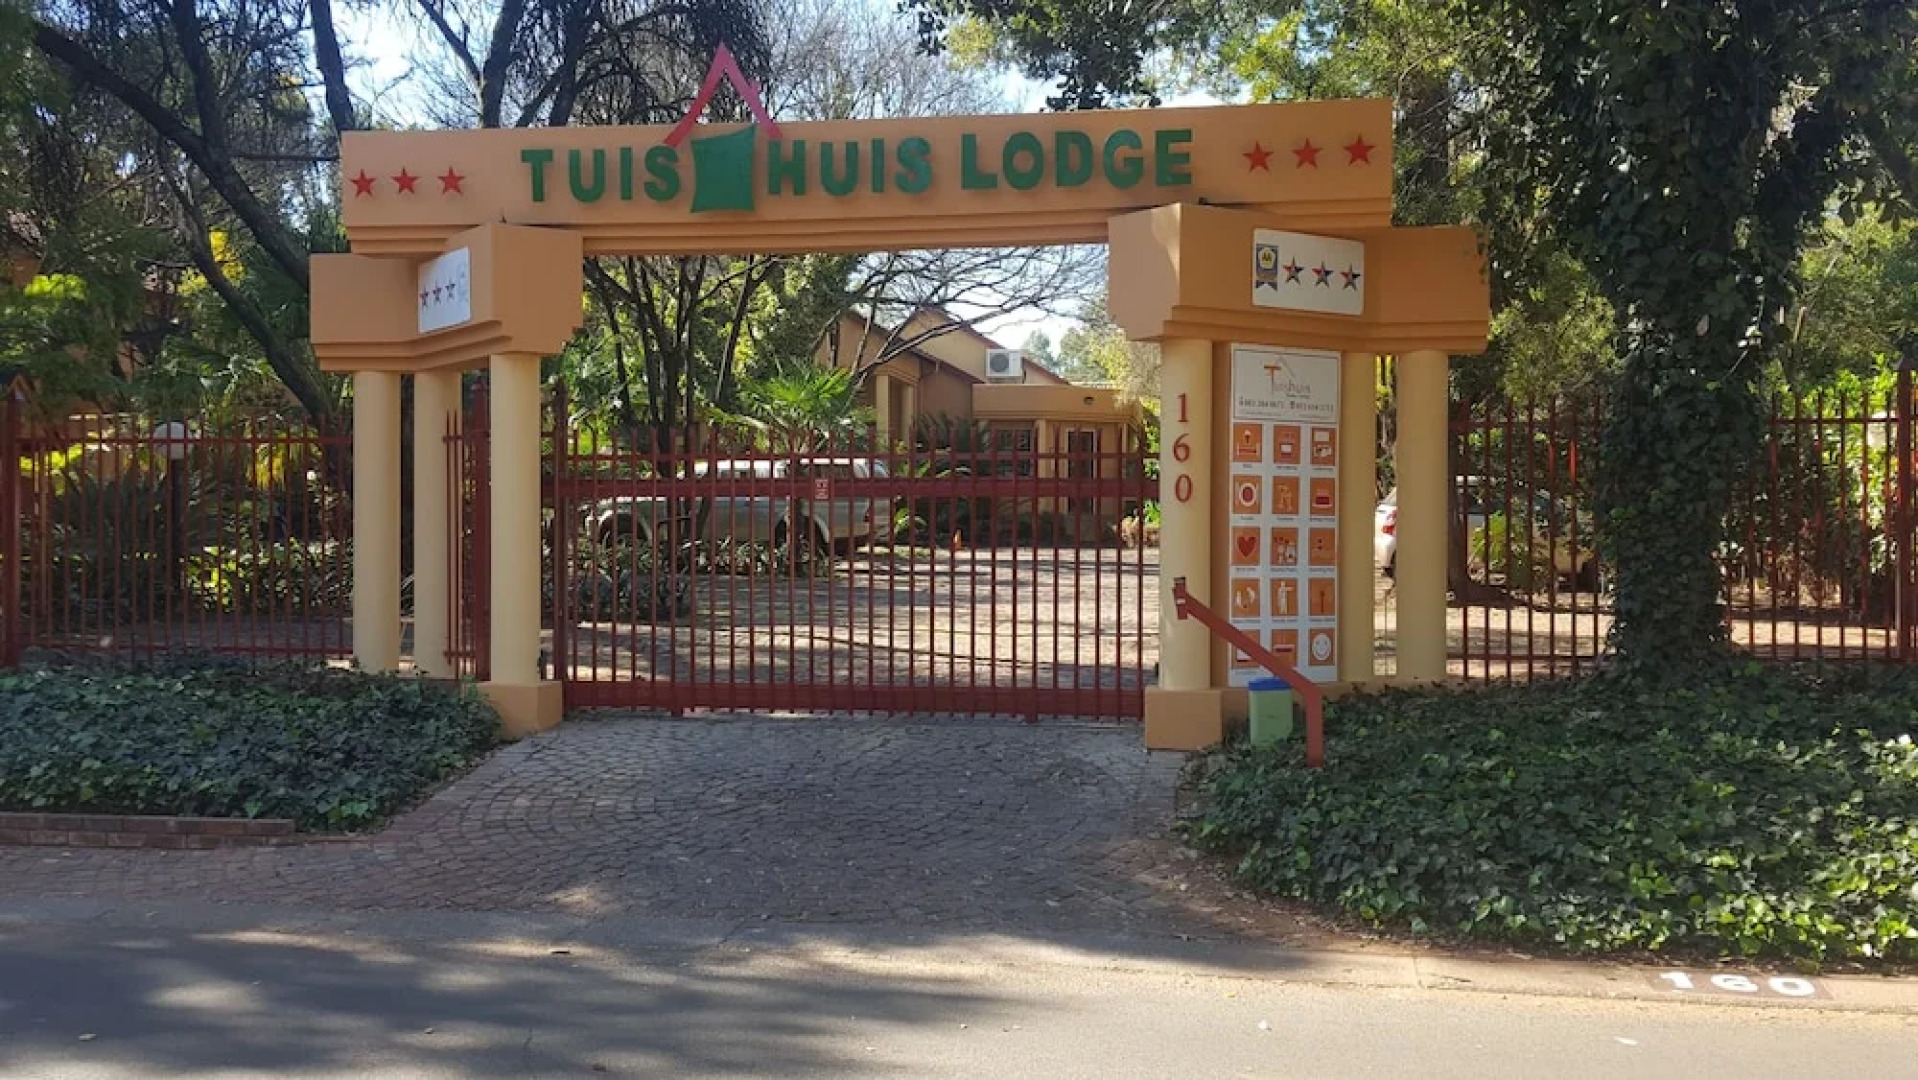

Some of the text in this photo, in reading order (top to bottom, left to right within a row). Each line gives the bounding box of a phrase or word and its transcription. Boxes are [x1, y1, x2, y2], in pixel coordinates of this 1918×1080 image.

[521, 129, 1193, 203] TUIS HUIS LODGE
[1173, 393, 1192, 503] 160
[1660, 971, 1816, 997] 160
